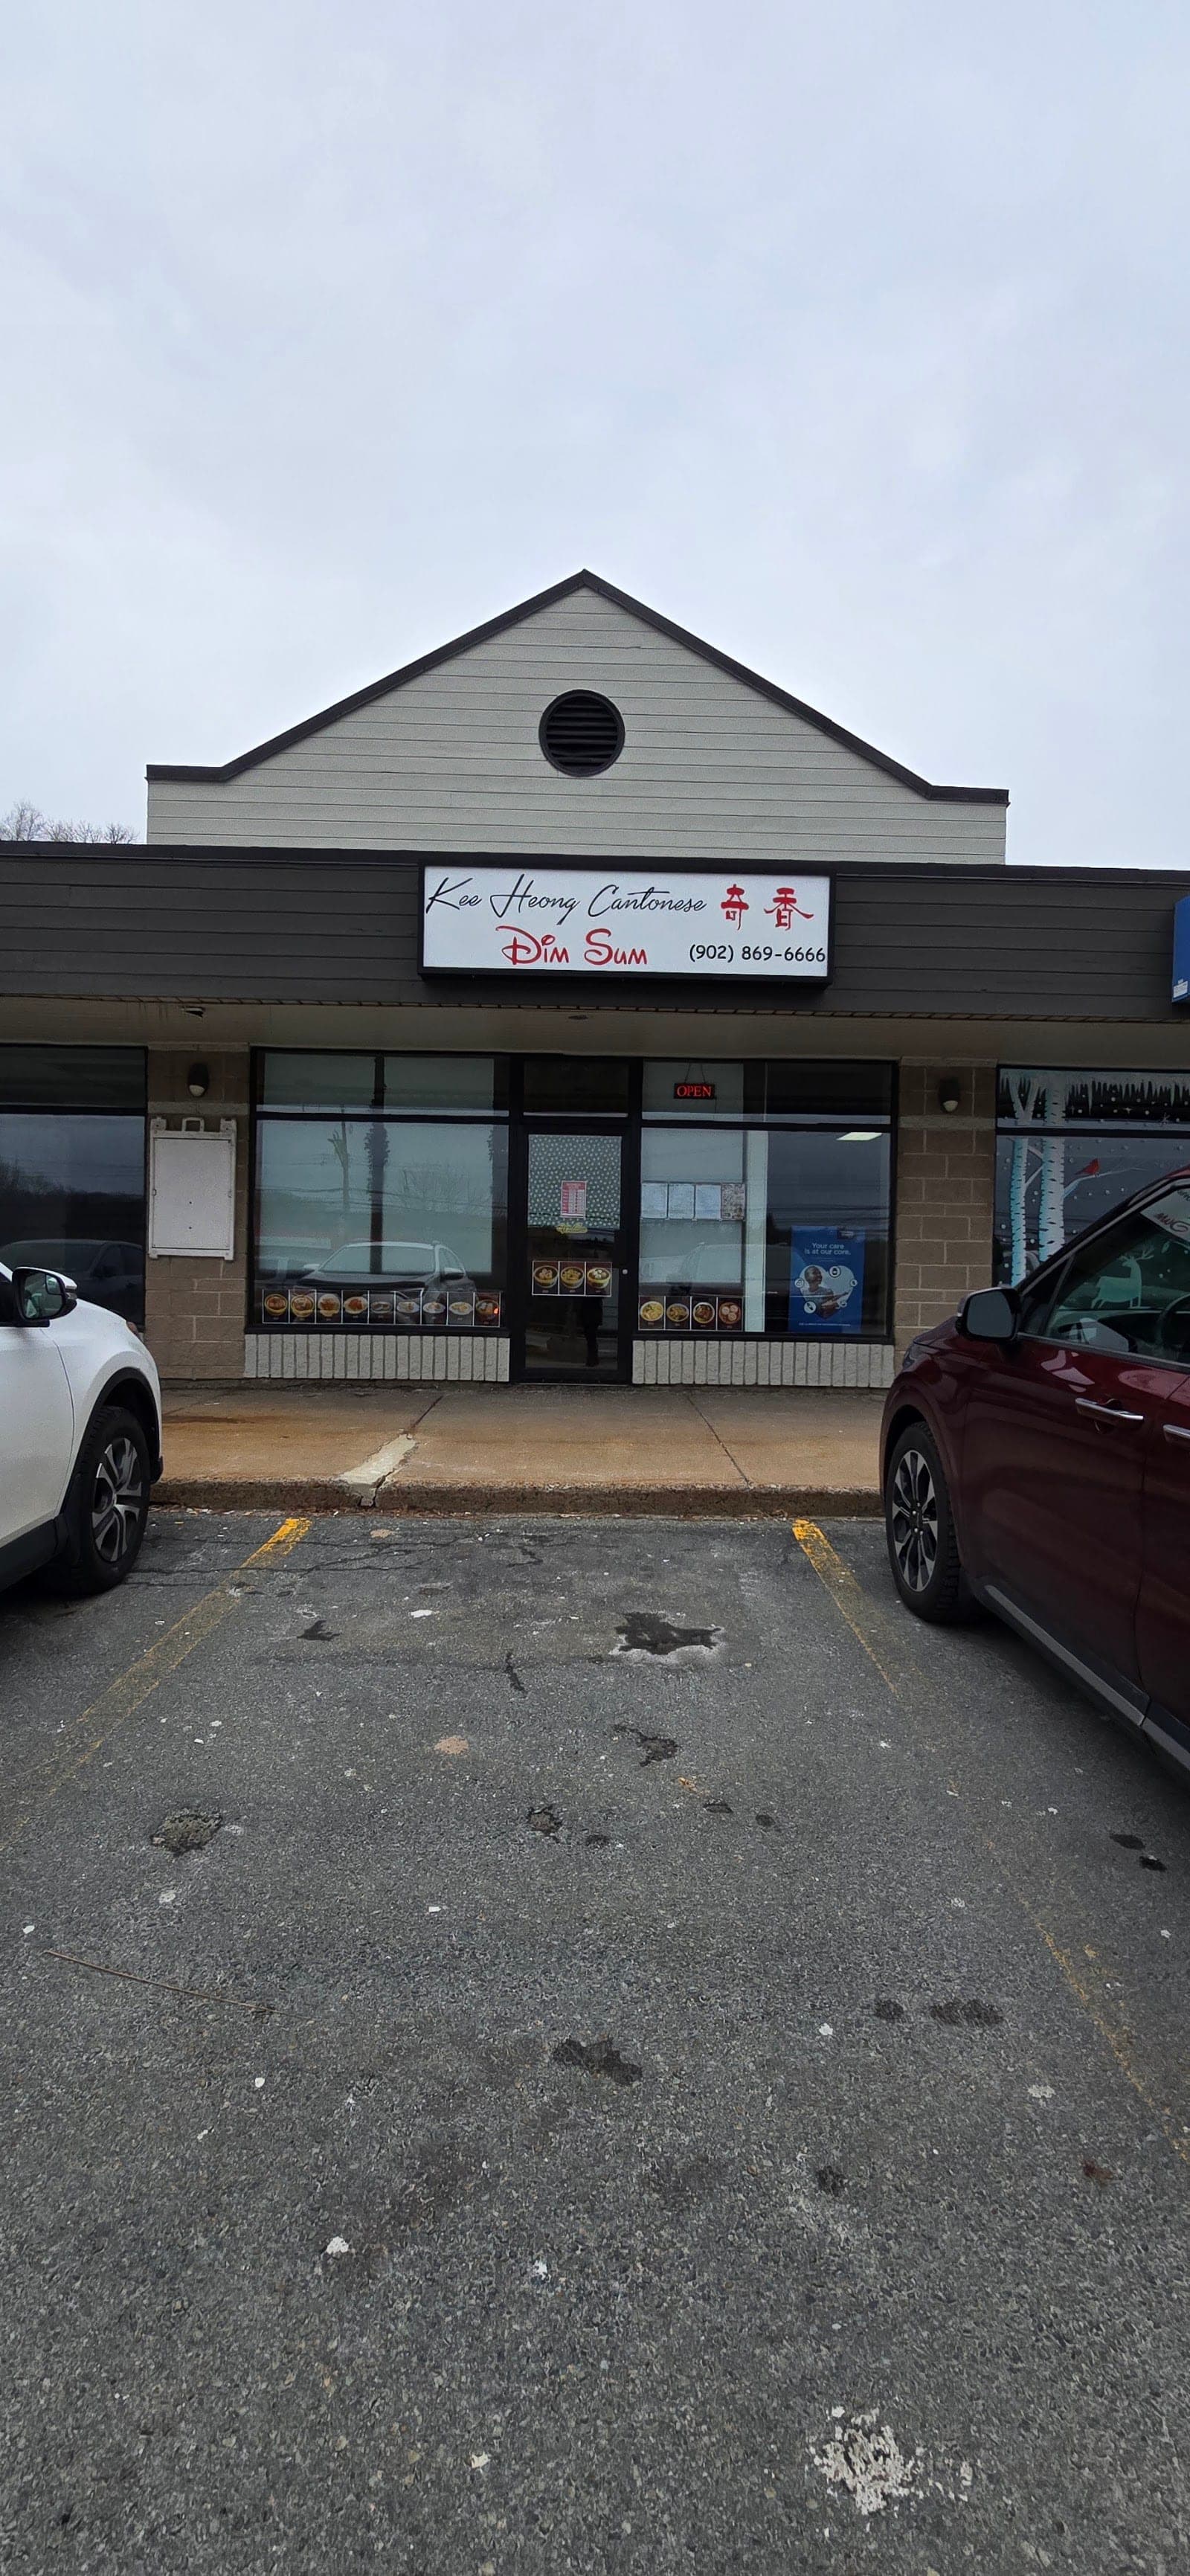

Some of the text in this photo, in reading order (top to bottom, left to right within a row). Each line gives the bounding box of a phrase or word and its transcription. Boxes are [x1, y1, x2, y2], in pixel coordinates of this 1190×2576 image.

[426, 873, 707, 925] Kee Heong Cantonese
[689, 943, 826, 963] (902) 869-6666
[676, 1085, 712, 1097] OPEN
